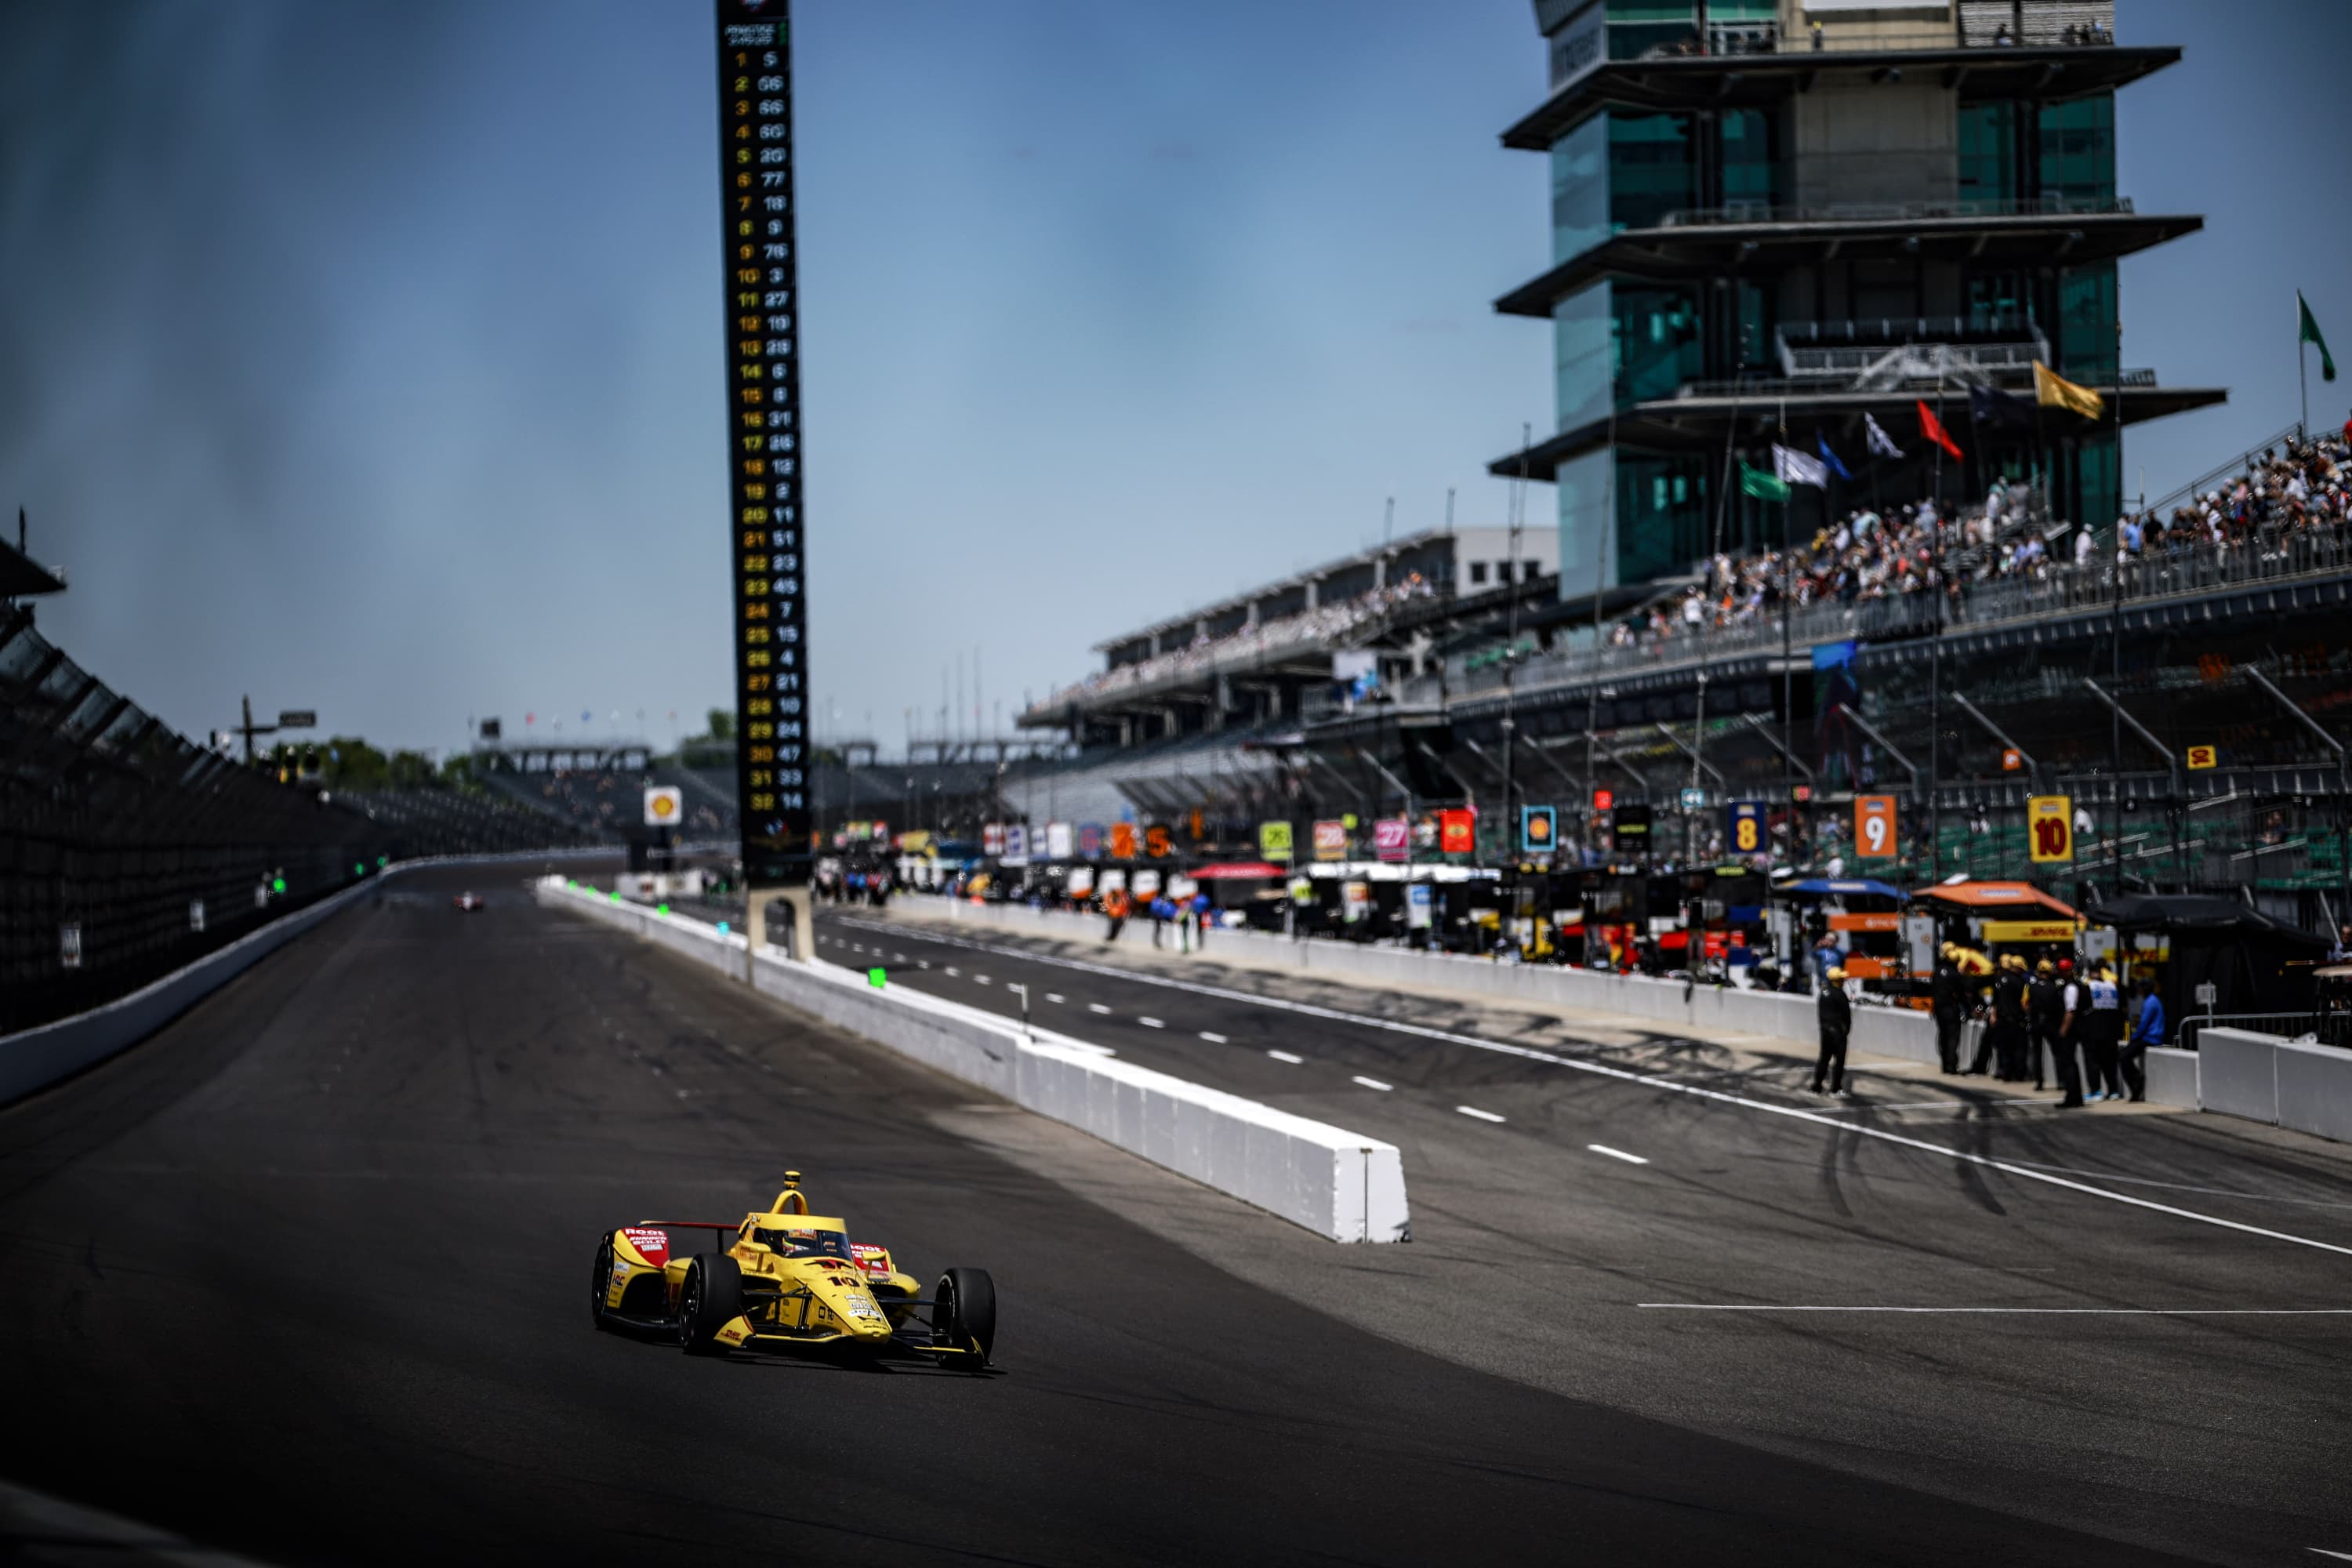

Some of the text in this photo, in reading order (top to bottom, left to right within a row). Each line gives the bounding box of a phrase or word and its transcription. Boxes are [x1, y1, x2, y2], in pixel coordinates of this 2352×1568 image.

[1737, 818, 1758, 851] 8
[1866, 816, 1886, 851] 9
[2036, 818, 2066, 855] 10
[828, 1276, 860, 1287] 10
